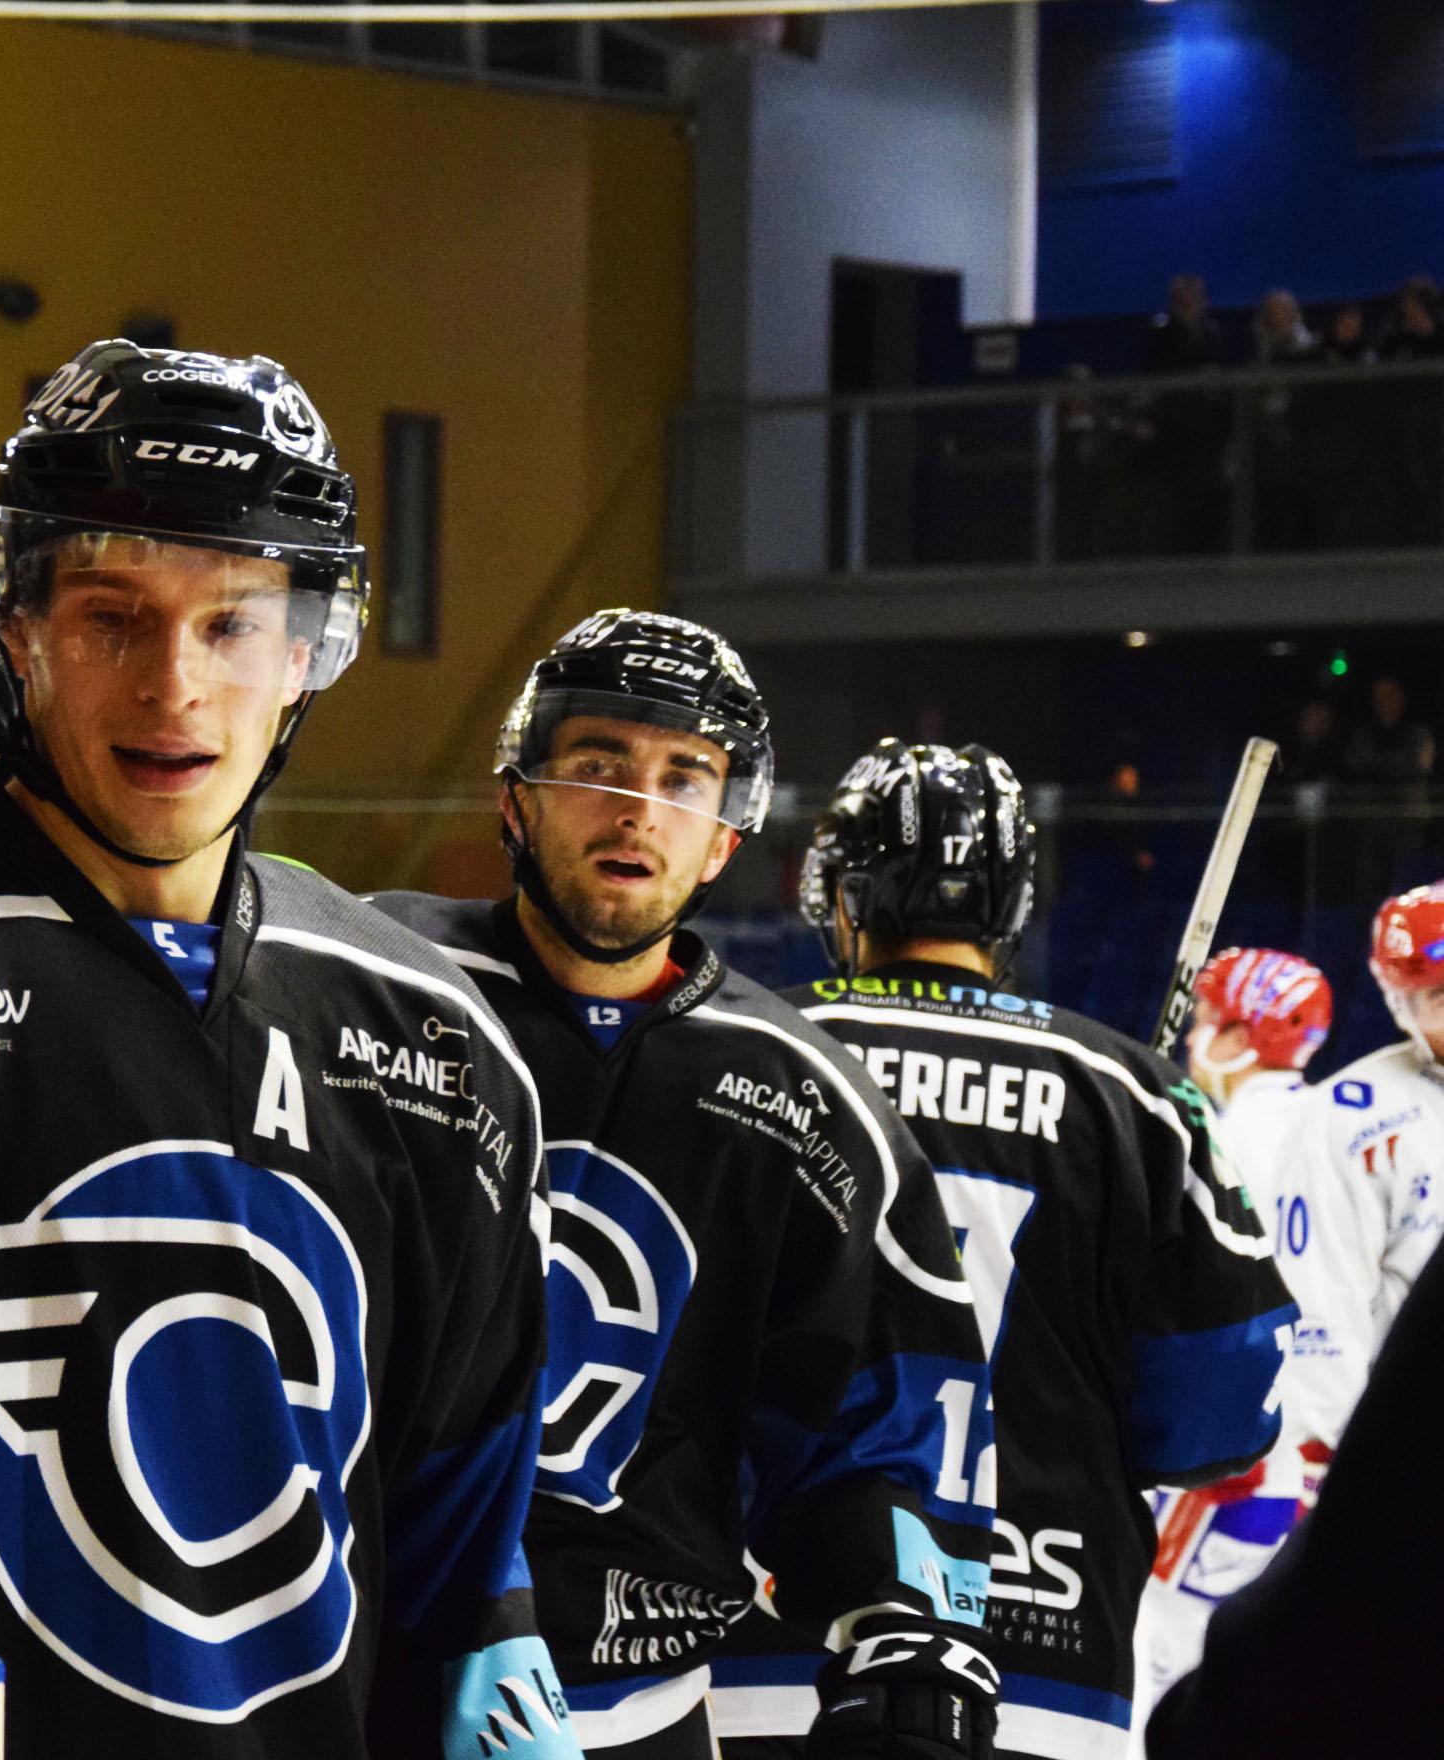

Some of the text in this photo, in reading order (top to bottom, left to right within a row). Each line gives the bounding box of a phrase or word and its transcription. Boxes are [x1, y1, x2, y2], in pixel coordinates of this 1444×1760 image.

[135, 439, 259, 470] CCM
[622, 652, 708, 681] CCM
[943, 836, 973, 864] 17
[152, 922, 189, 958] 5
[588, 1006, 621, 1025] 12
[253, 1026, 310, 1152] A
[1276, 1196, 1309, 1257] 10
